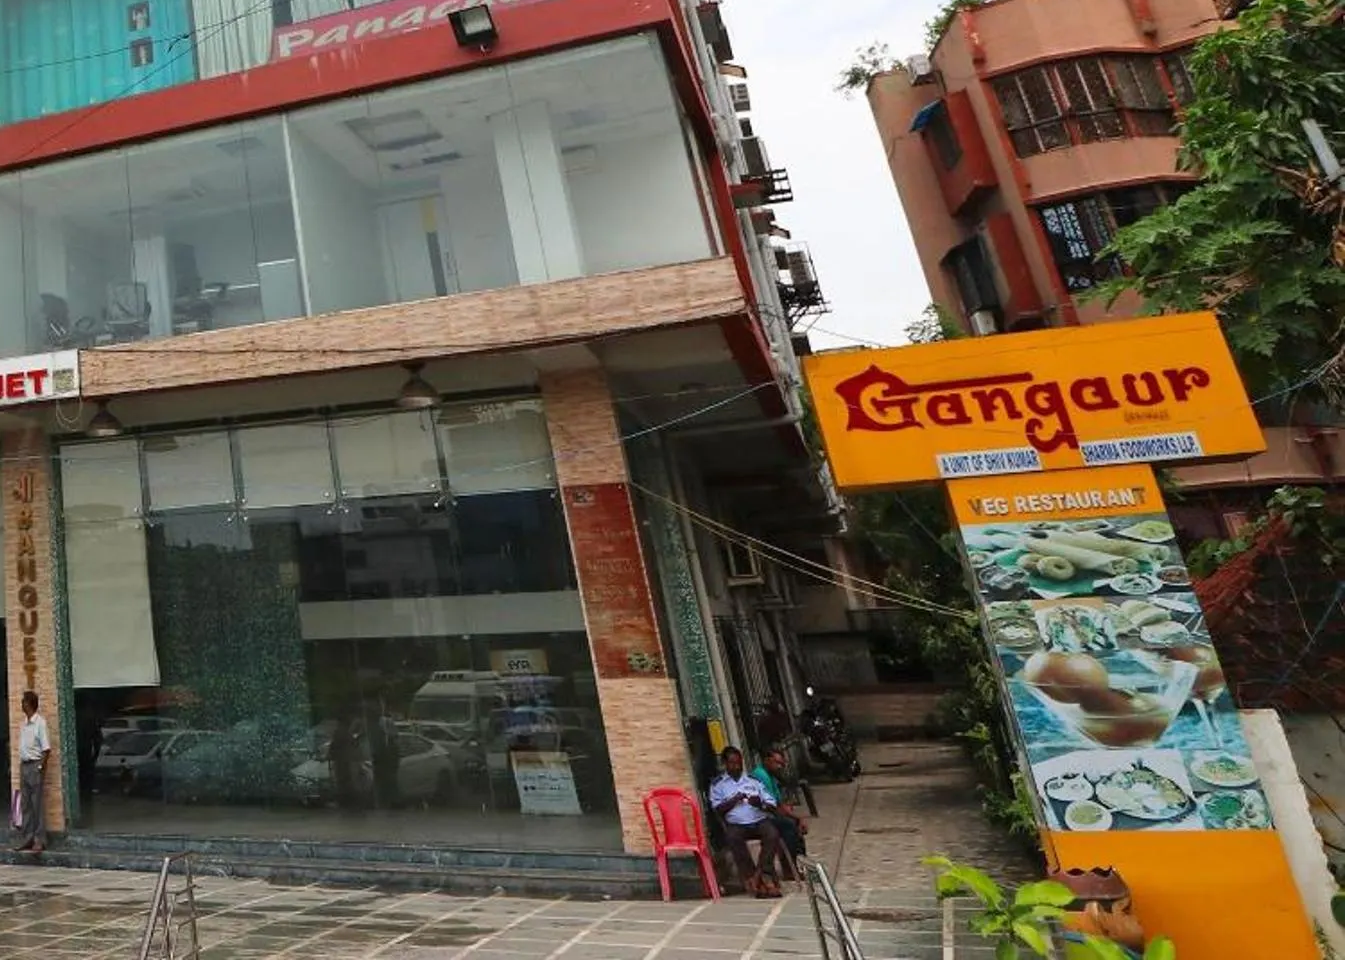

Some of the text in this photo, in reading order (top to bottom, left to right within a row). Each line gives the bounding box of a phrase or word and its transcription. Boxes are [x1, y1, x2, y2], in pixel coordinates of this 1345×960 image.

[833, 363, 1211, 454] Gangaur
[949, 455, 971, 474] UNIT
[971, 454, 985, 472] OF
[986, 452, 1007, 472] SHIV
[1007, 449, 1039, 470] KUMAR
[1082, 442, 1121, 463] SHARMA
[1121, 437, 1178, 461] FOODWORKS
[968, 486, 1146, 517] VEG RESTAURANT
[17, 505, 40, 690] BANQUET
